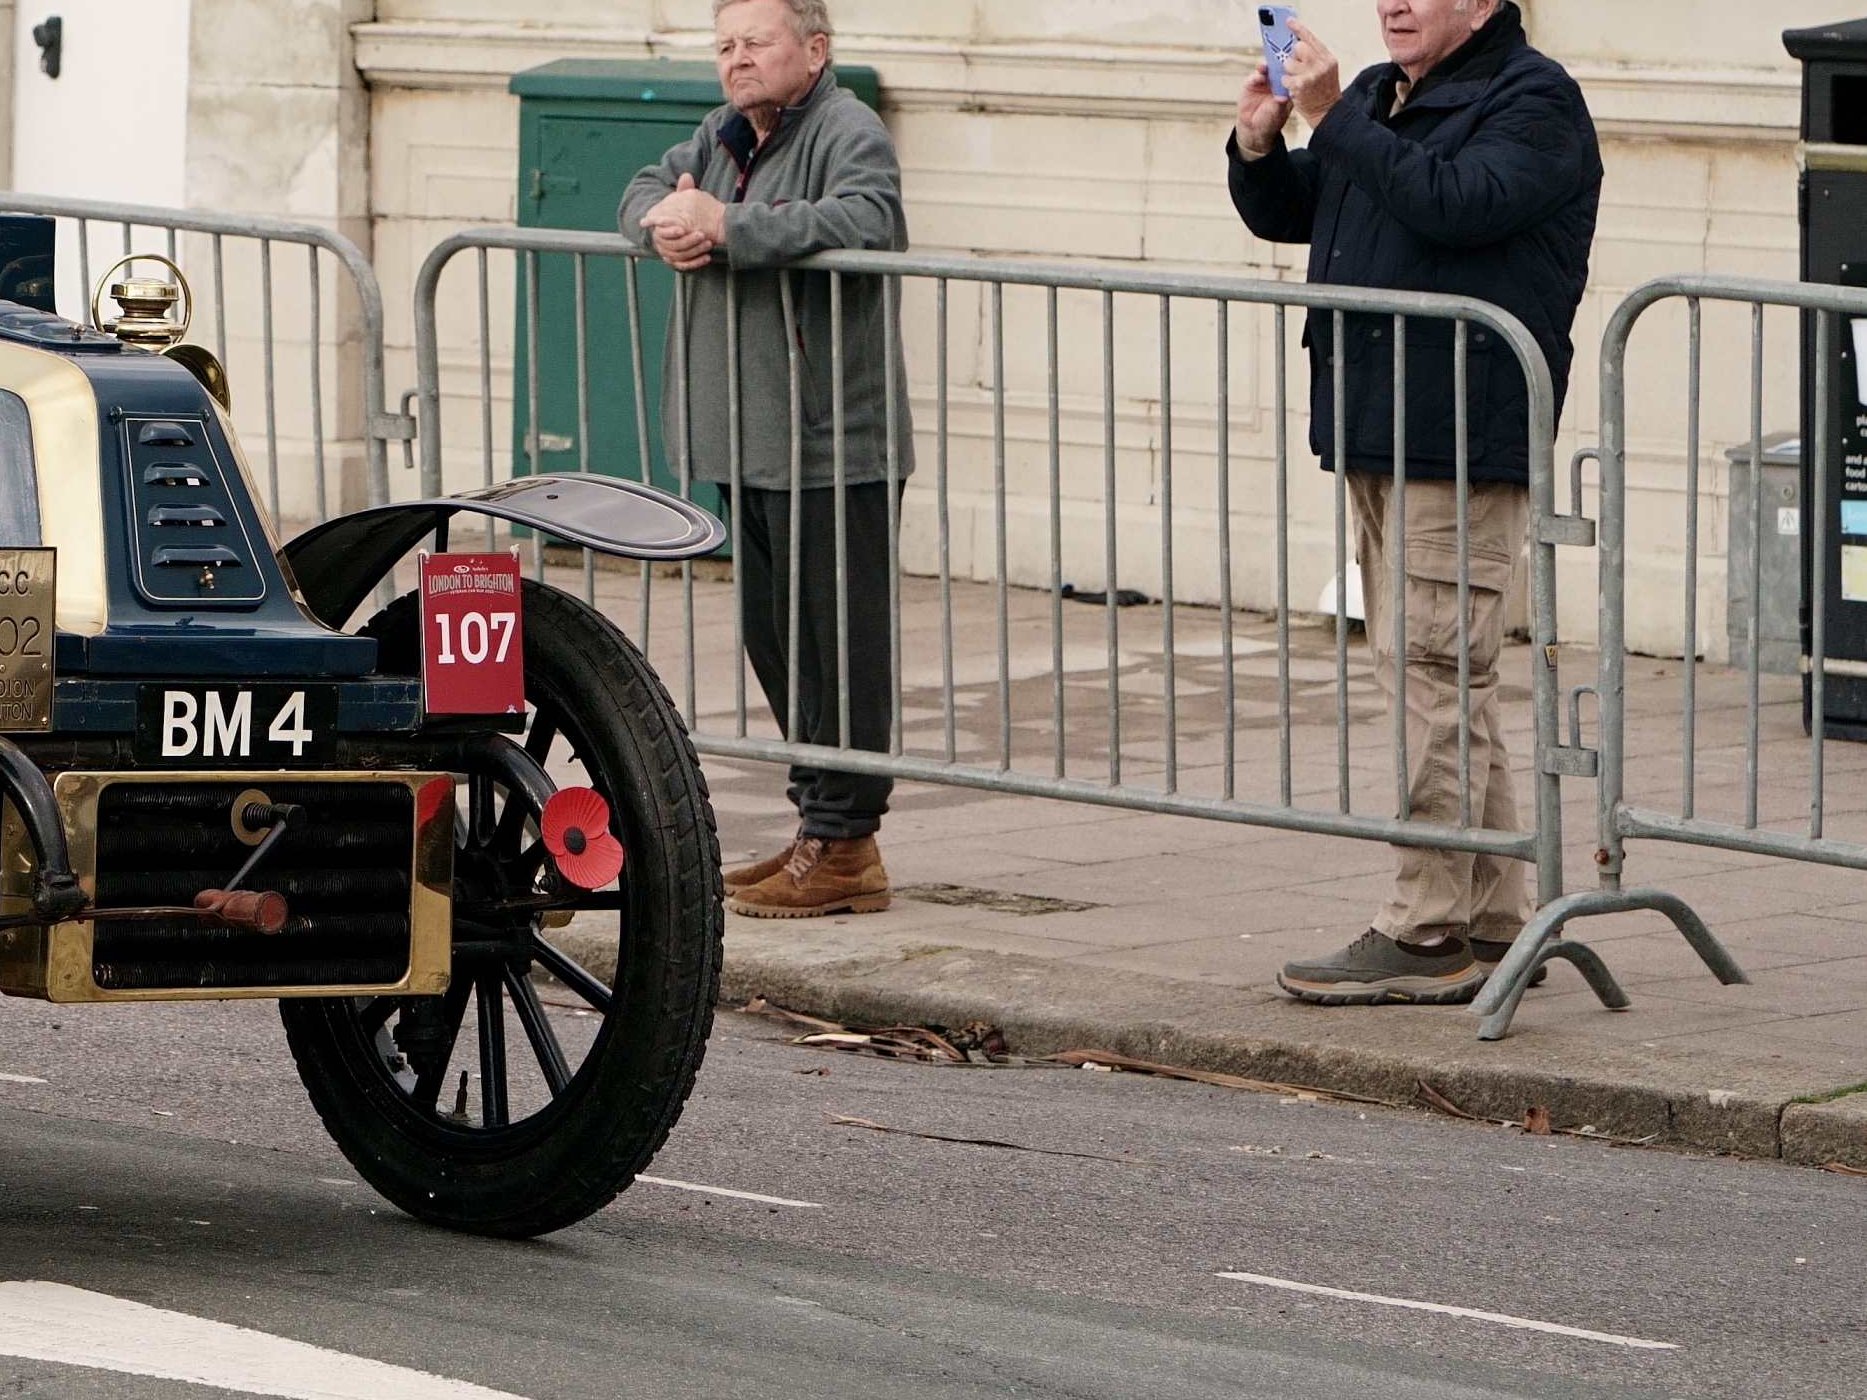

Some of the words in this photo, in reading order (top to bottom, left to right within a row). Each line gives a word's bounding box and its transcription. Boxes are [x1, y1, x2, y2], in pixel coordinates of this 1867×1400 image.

[1845, 466, 1866, 479] food
[428, 574, 460, 595] LONDON
[462, 574, 473, 588] TO
[474, 573, 514, 593] BRIGHTON
[435, 612, 515, 664] 107
[162, 691, 252, 756] BM
[269, 691, 313, 756] 4
